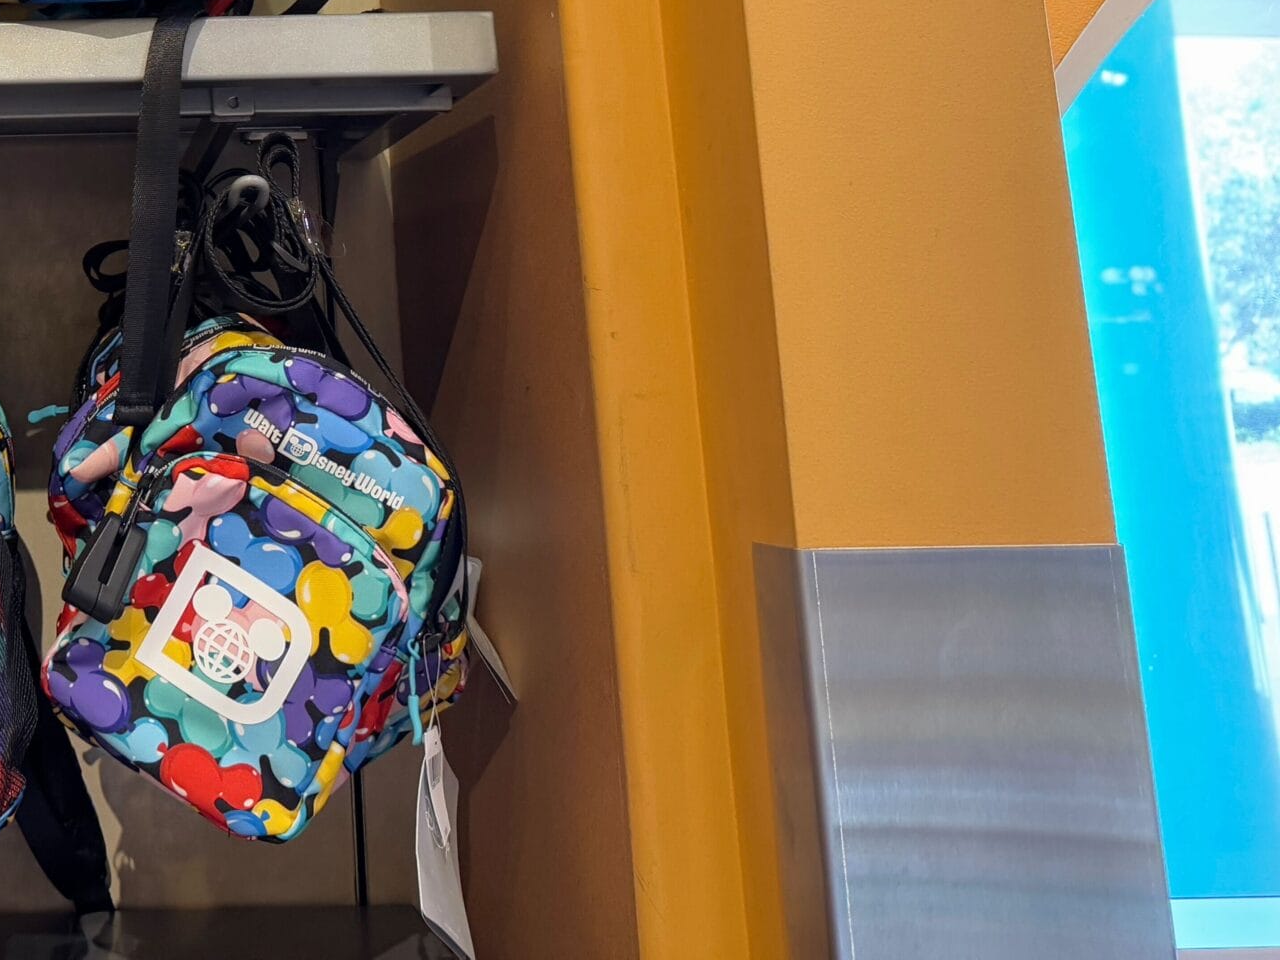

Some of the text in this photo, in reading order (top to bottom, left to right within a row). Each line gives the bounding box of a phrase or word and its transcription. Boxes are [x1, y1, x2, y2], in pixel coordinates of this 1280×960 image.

[243, 408, 405, 510] Walt Disney World
